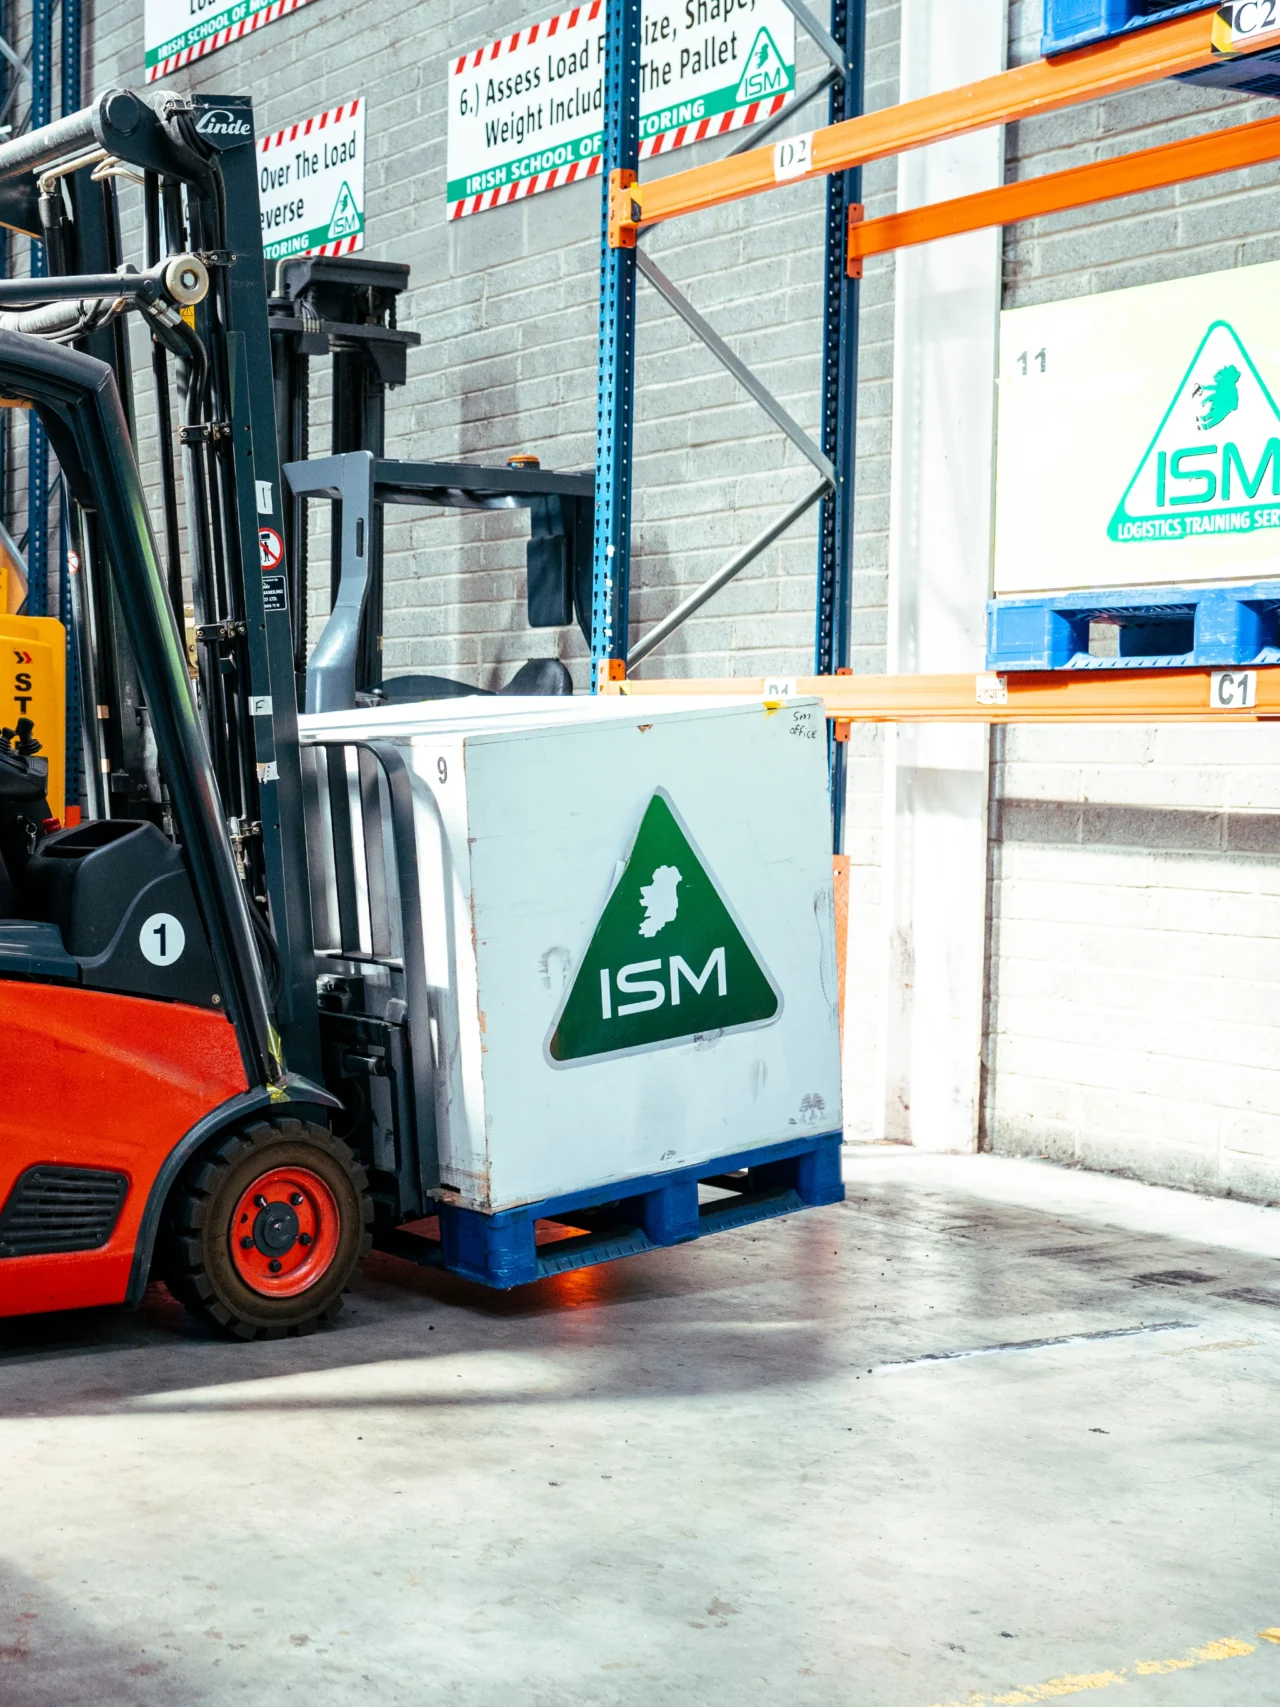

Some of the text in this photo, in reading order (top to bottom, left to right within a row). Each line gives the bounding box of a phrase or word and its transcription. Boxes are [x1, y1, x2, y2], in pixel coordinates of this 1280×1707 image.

[158, 35, 185, 60] IRISH
[188, 13, 230, 44] SCHOOL
[232, 3, 247, 20] OF
[1234, 0, 1277, 34] C2
[460, 83, 480, 118] 6.)
[485, 66, 541, 107] Assess
[548, 39, 589, 82] Load
[597, 34, 606, 64] F
[641, 15, 677, 42] ize,
[744, 67, 781, 97] ISM
[485, 31, 737, 148] Weight Includ The Pallet
[195, 110, 251, 135] Linde
[261, 130, 356, 193] Over The Load
[466, 99, 705, 195] IRISH SCHOOL OF TORING
[779, 139, 808, 168] D2
[261, 198, 304, 230] everse
[333, 213, 356, 235] ISM
[263, 234, 309, 259] TORING
[1017, 348, 1046, 375] 11
[1156, 437, 1280, 507] ISM
[1118, 508, 1280, 539] LOGISTICS TRAINING SER
[1219, 674, 1248, 705] C1
[437, 757, 449, 784] 9
[154, 924, 167, 957] 1
[599, 947, 728, 1019] ISM
